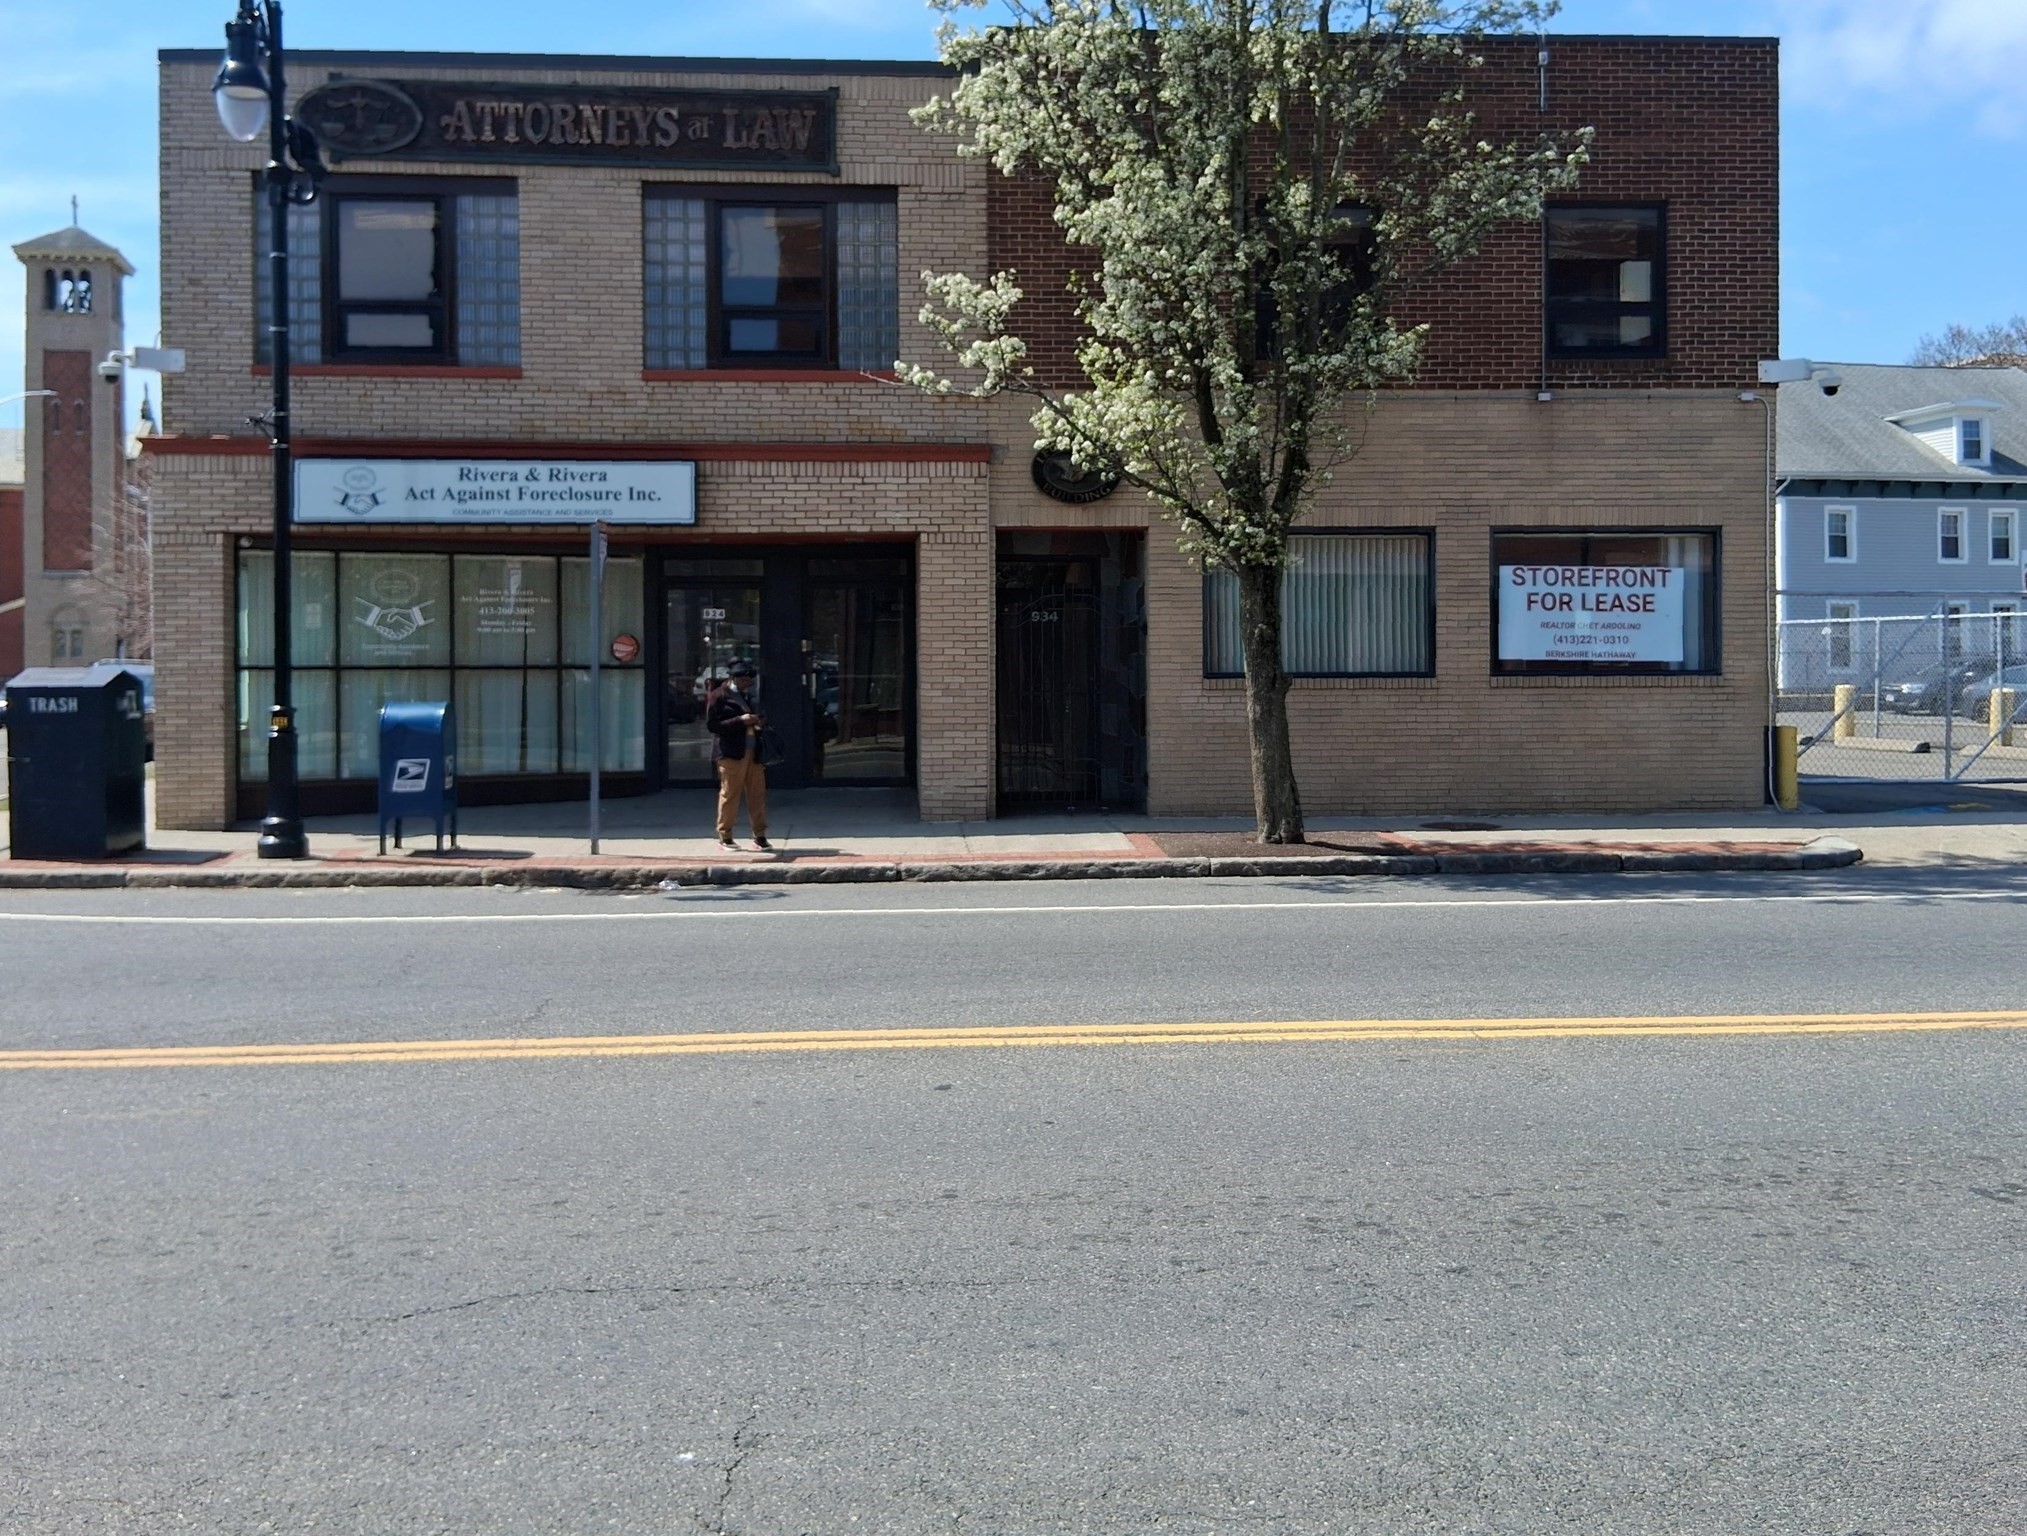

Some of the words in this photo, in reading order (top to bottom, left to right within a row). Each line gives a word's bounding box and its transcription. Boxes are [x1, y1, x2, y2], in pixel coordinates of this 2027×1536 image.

[440, 100, 680, 147] ATTORNEYS
[722, 107, 816, 150] LAW
[459, 466, 518, 482] Rivera
[525, 467, 540, 482] &
[549, 467, 608, 483] Rivera
[404, 487, 436, 501] Act
[442, 487, 511, 504] Against
[517, 487, 621, 502] Foreclosure
[629, 487, 662, 502] Inc.
[452, 508, 501, 516] COMMUNITY
[503, 508, 552, 516] ASSISTANCE
[555, 508, 572, 516] AND
[574, 508, 614, 516] SERVICES
[1512, 566, 1672, 588] STOREFRONT
[1527, 592, 1573, 611] FOR
[1581, 592, 1656, 613] LEASE
[1540, 621, 1576, 630] REALTOR
[1601, 622, 1642, 630] ARDOLINO
[1553, 634, 1630, 646] (413)221-0310
[1545, 650, 1590, 659] BERKSHIRE
[1591, 650, 1637, 659] HATHAWAY
[28, 697, 79, 713] TRASH
